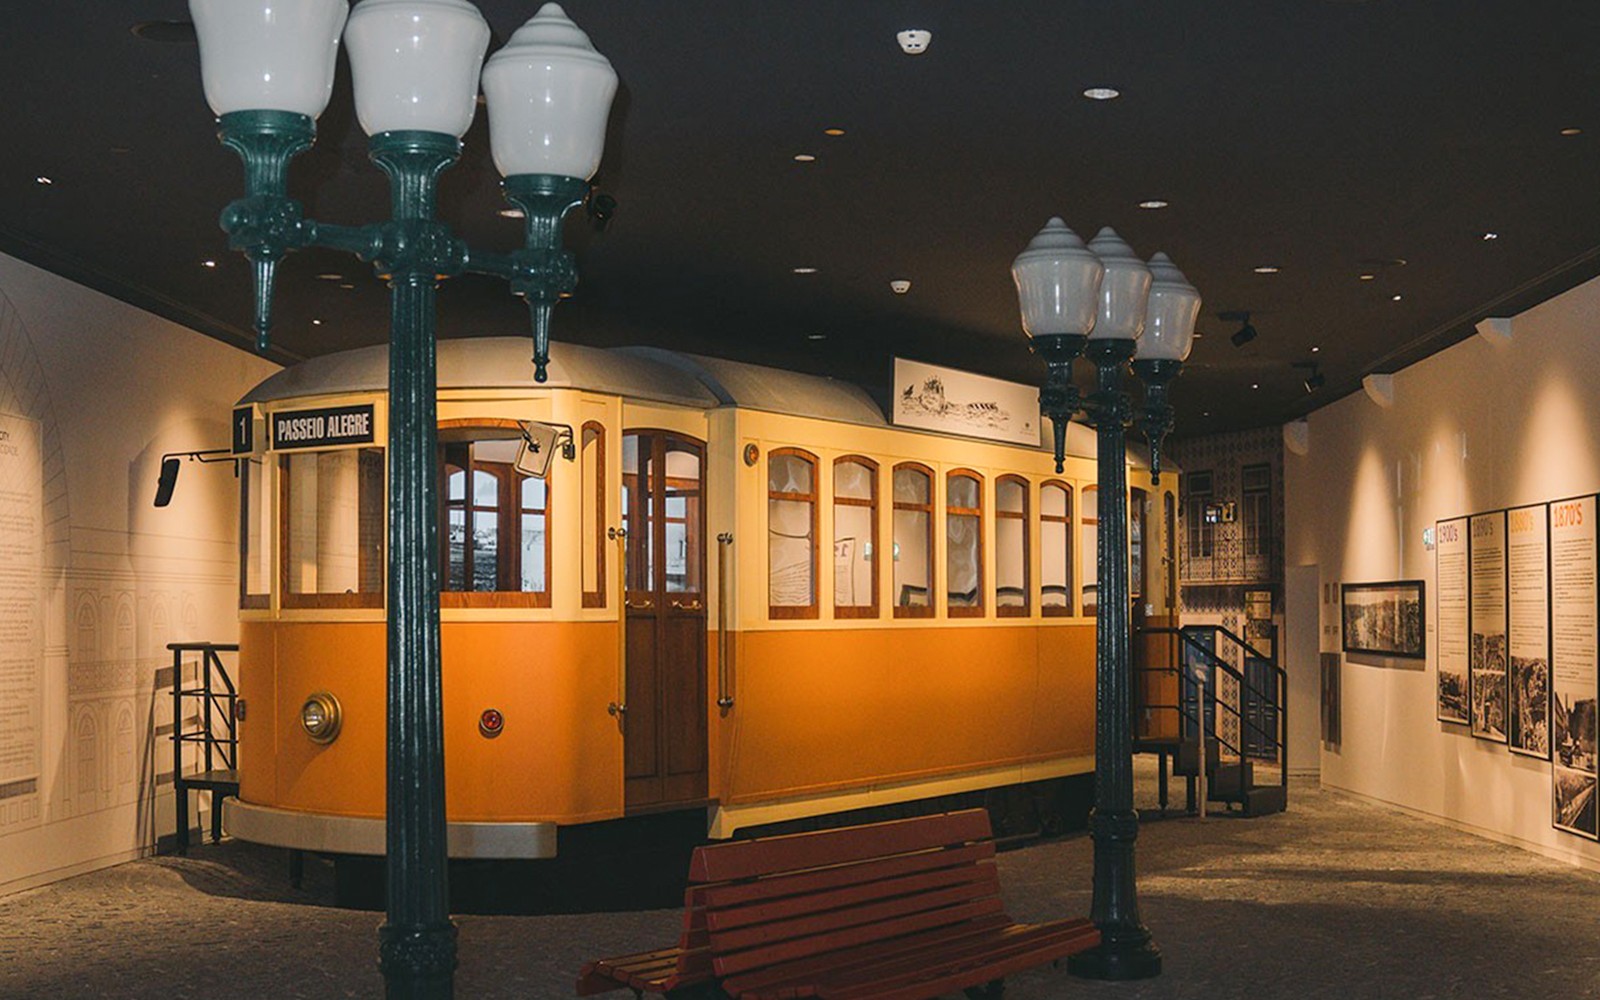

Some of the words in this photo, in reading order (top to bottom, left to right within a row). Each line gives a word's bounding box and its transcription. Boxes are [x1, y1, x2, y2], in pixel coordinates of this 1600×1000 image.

[240, 416, 246, 445] 1
[278, 417, 324, 441] PASSEIO
[327, 413, 369, 438] ALEGRE
